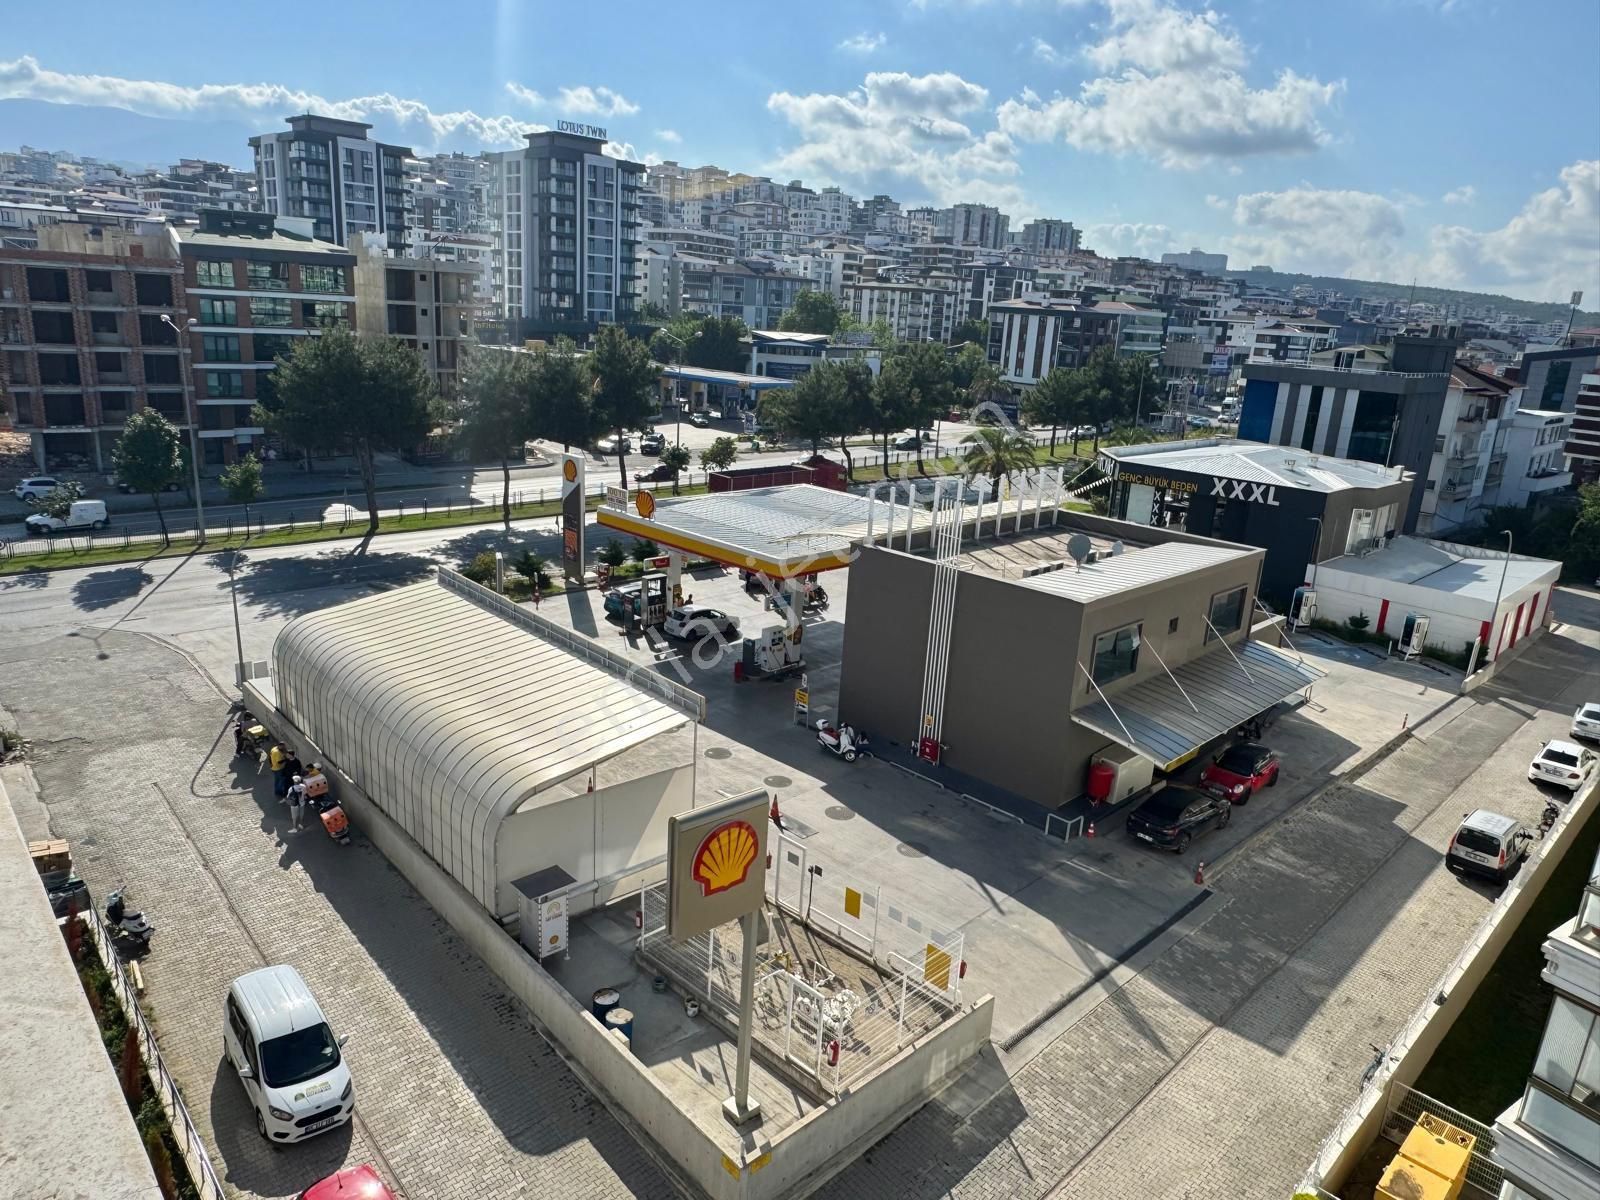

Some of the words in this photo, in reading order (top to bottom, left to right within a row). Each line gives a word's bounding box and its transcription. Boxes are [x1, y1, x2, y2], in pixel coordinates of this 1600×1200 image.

[557, 120, 584, 135] LOTUS
[586, 125, 607, 139] TWIN
[1170, 480, 1198, 493] BEDEN
[1210, 477, 1280, 507] XXXL
